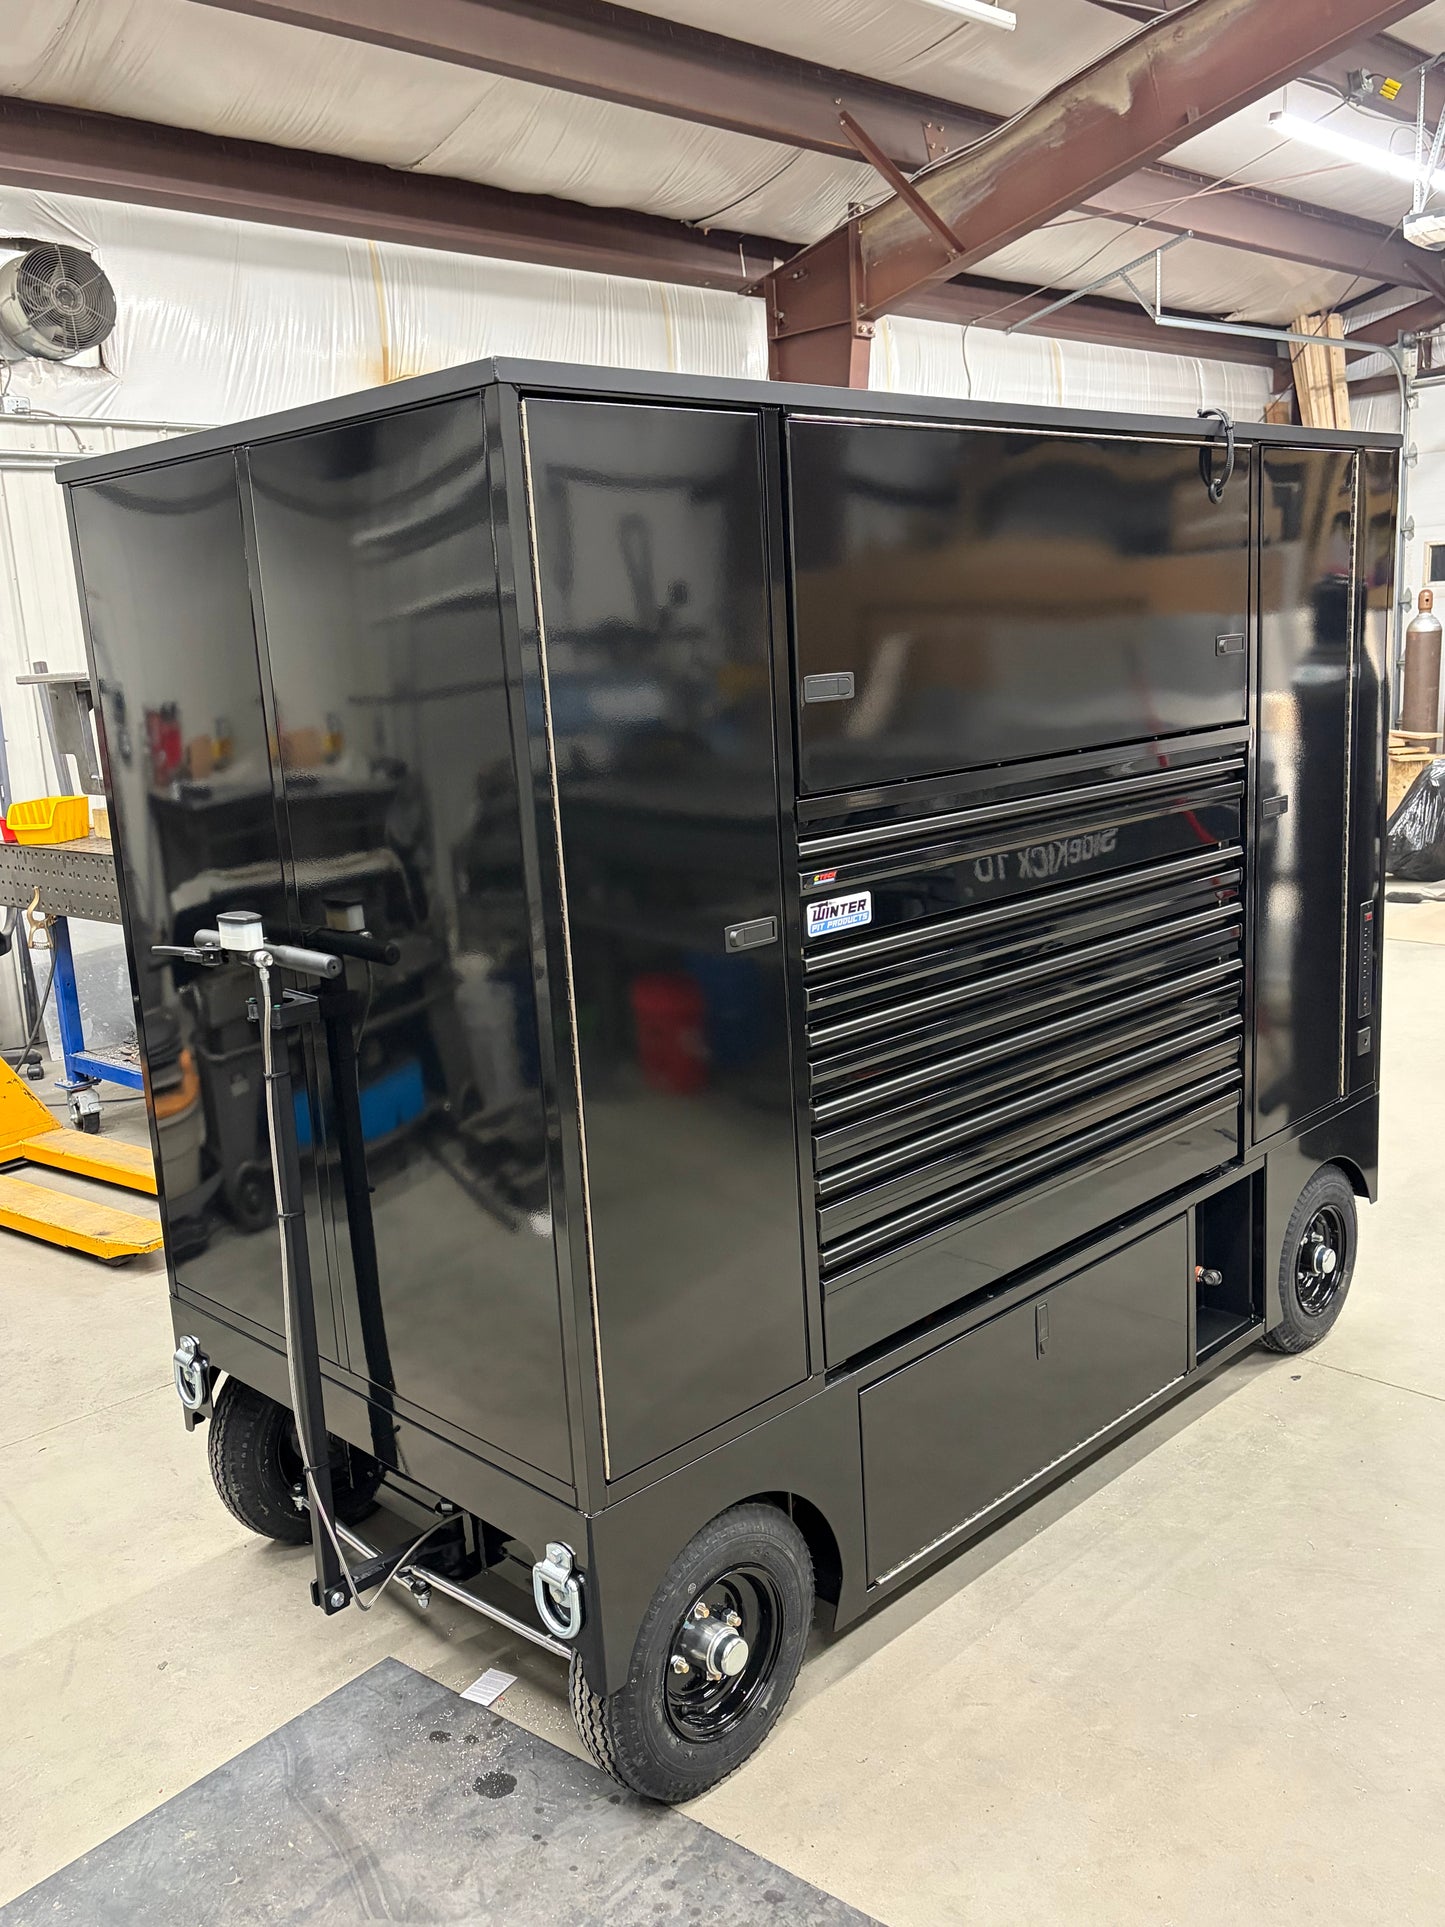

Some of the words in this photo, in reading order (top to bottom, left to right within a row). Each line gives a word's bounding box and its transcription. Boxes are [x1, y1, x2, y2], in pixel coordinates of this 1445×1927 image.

[810, 899, 867, 922] WINTER
[811, 922, 826, 933] PIT
[826, 913, 868, 929] PRODUCTS
